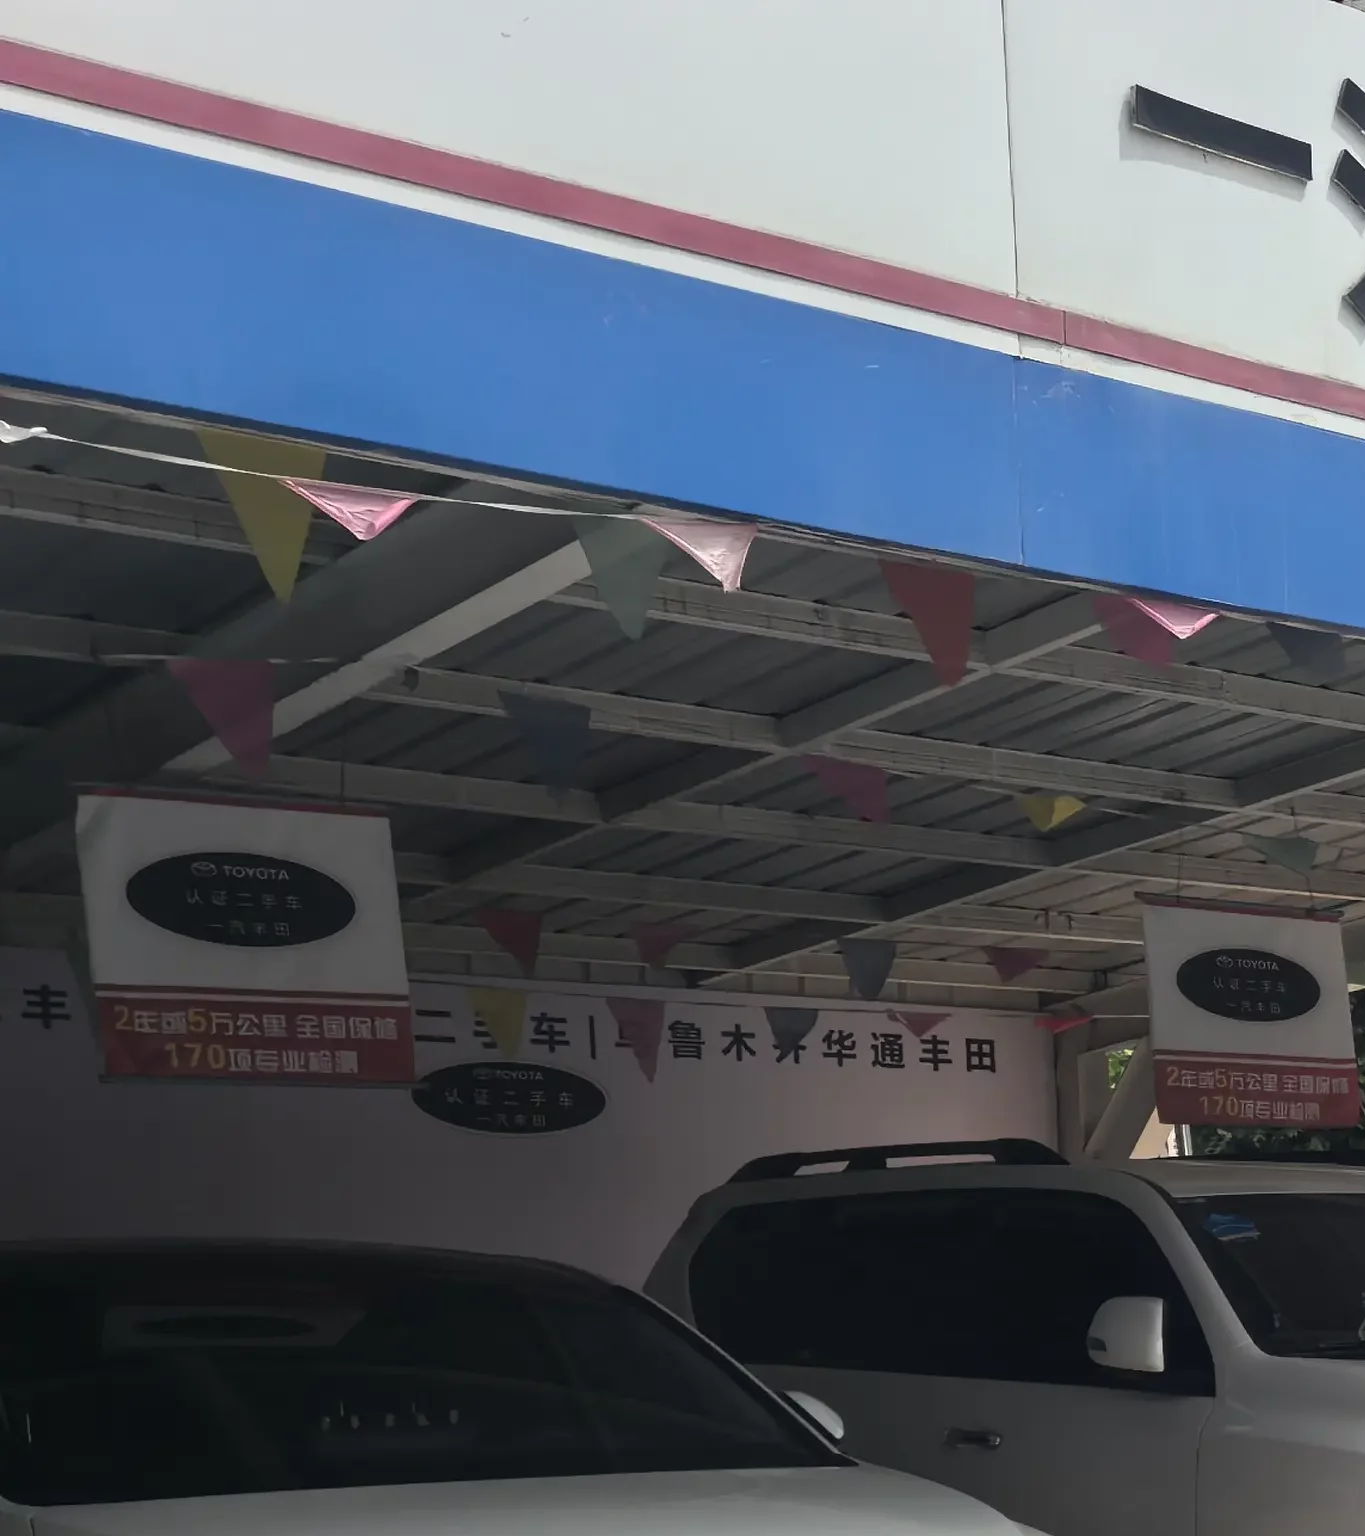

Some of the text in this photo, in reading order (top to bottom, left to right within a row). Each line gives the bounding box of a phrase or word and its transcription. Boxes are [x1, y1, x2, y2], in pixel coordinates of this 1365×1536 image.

[223, 863, 290, 881] TOYOTA
[1237, 958, 1280, 972] TOYOTA
[495, 1069, 544, 1081] TOYOTA
